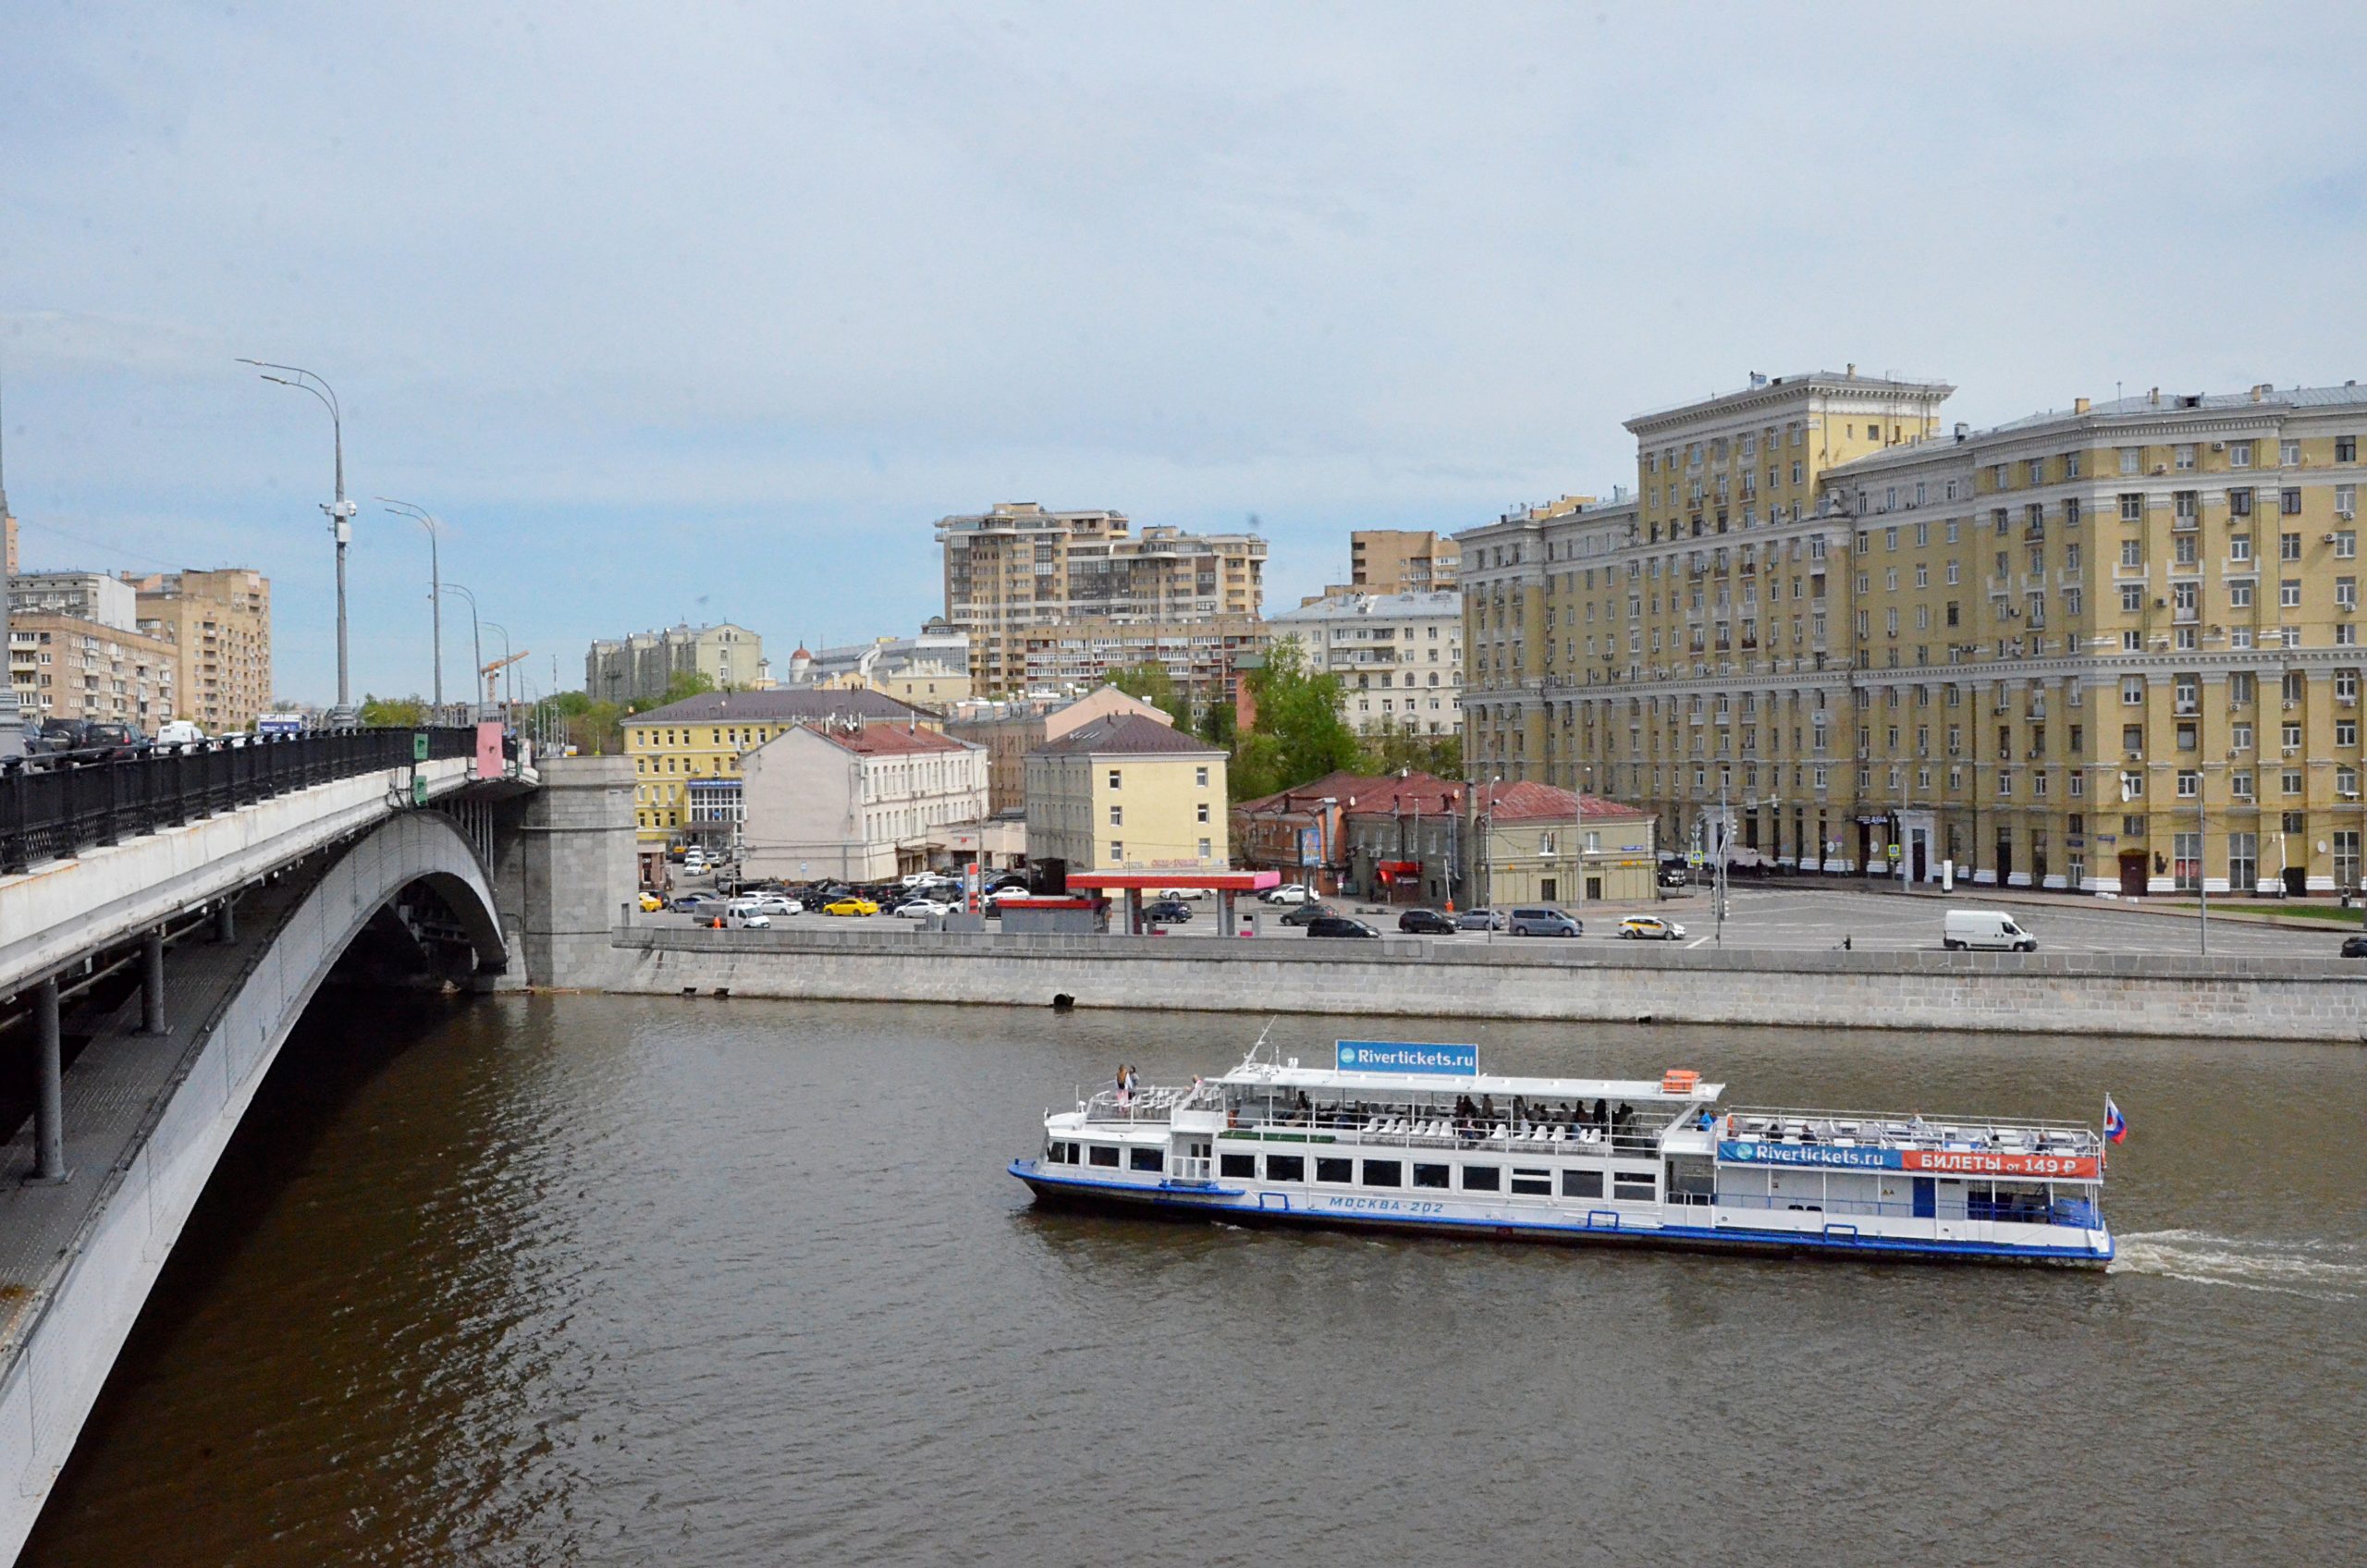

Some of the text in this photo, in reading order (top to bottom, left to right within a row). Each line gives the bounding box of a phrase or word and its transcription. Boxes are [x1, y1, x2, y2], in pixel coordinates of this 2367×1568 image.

[1358, 1049, 1474, 1066] Rivertickets.ru
[1757, 1145, 1883, 1165] Rivertickets.ru
[1920, 1154, 2001, 1170] БИЛЕТЫ
[2006, 1162, 2020, 1171] от
[2024, 1158, 2058, 1172] 149
